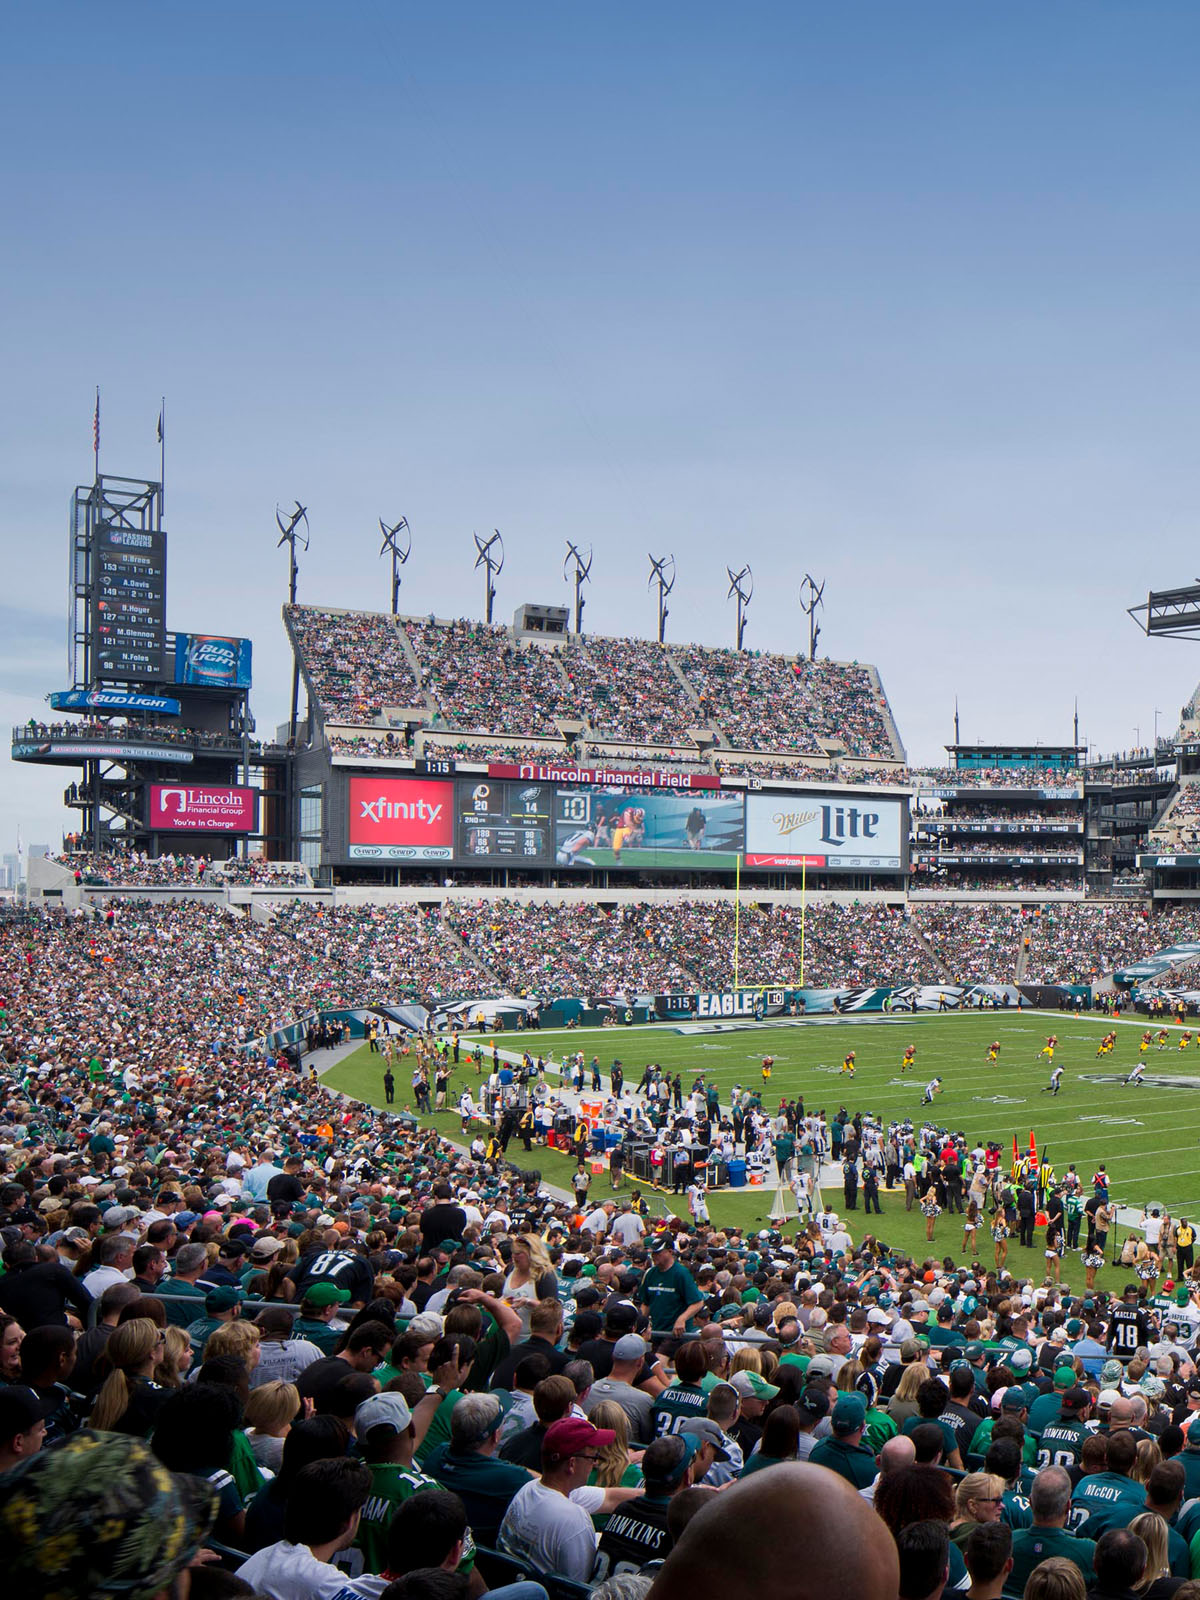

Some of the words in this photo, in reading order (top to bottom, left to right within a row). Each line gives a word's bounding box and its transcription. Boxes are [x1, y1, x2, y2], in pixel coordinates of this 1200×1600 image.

[122, 533, 152, 542] PASSING
[122, 539, 152, 548] LEADERS
[199, 644, 234, 658] BUD
[192, 652, 236, 667] LIGHT
[93, 694, 126, 704] BUD
[126, 695, 167, 708] LIGHT
[426, 761, 449, 772] 1:15
[538, 768, 590, 782] Lincoln
[595, 770, 656, 786] Financial
[660, 772, 691, 787] Field
[188, 790, 243, 805] Lincoln
[360, 797, 442, 824] xfinity
[474, 801, 487, 811] 20
[526, 803, 537, 813] 14
[564, 798, 584, 819] 10
[207, 820, 234, 828] Charge
[772, 811, 818, 832] Miller
[820, 805, 879, 846] Lite
[774, 857, 801, 866] verizon
[1156, 857, 1176, 866] ACME
[666, 998, 690, 1009] 1:15
[822, 1218, 829, 1228] 8
[310, 1252, 354, 1277] 87
[1115, 1311, 1137, 1320] MACLIN
[1116, 1324, 1138, 1349] 18
[662, 1388, 705, 1407] WESTBROOK
[1042, 1427, 1080, 1442] DAWKINS
[1085, 1484, 1121, 1501] McCOY
[603, 1513, 666, 1549] DAWKINS
